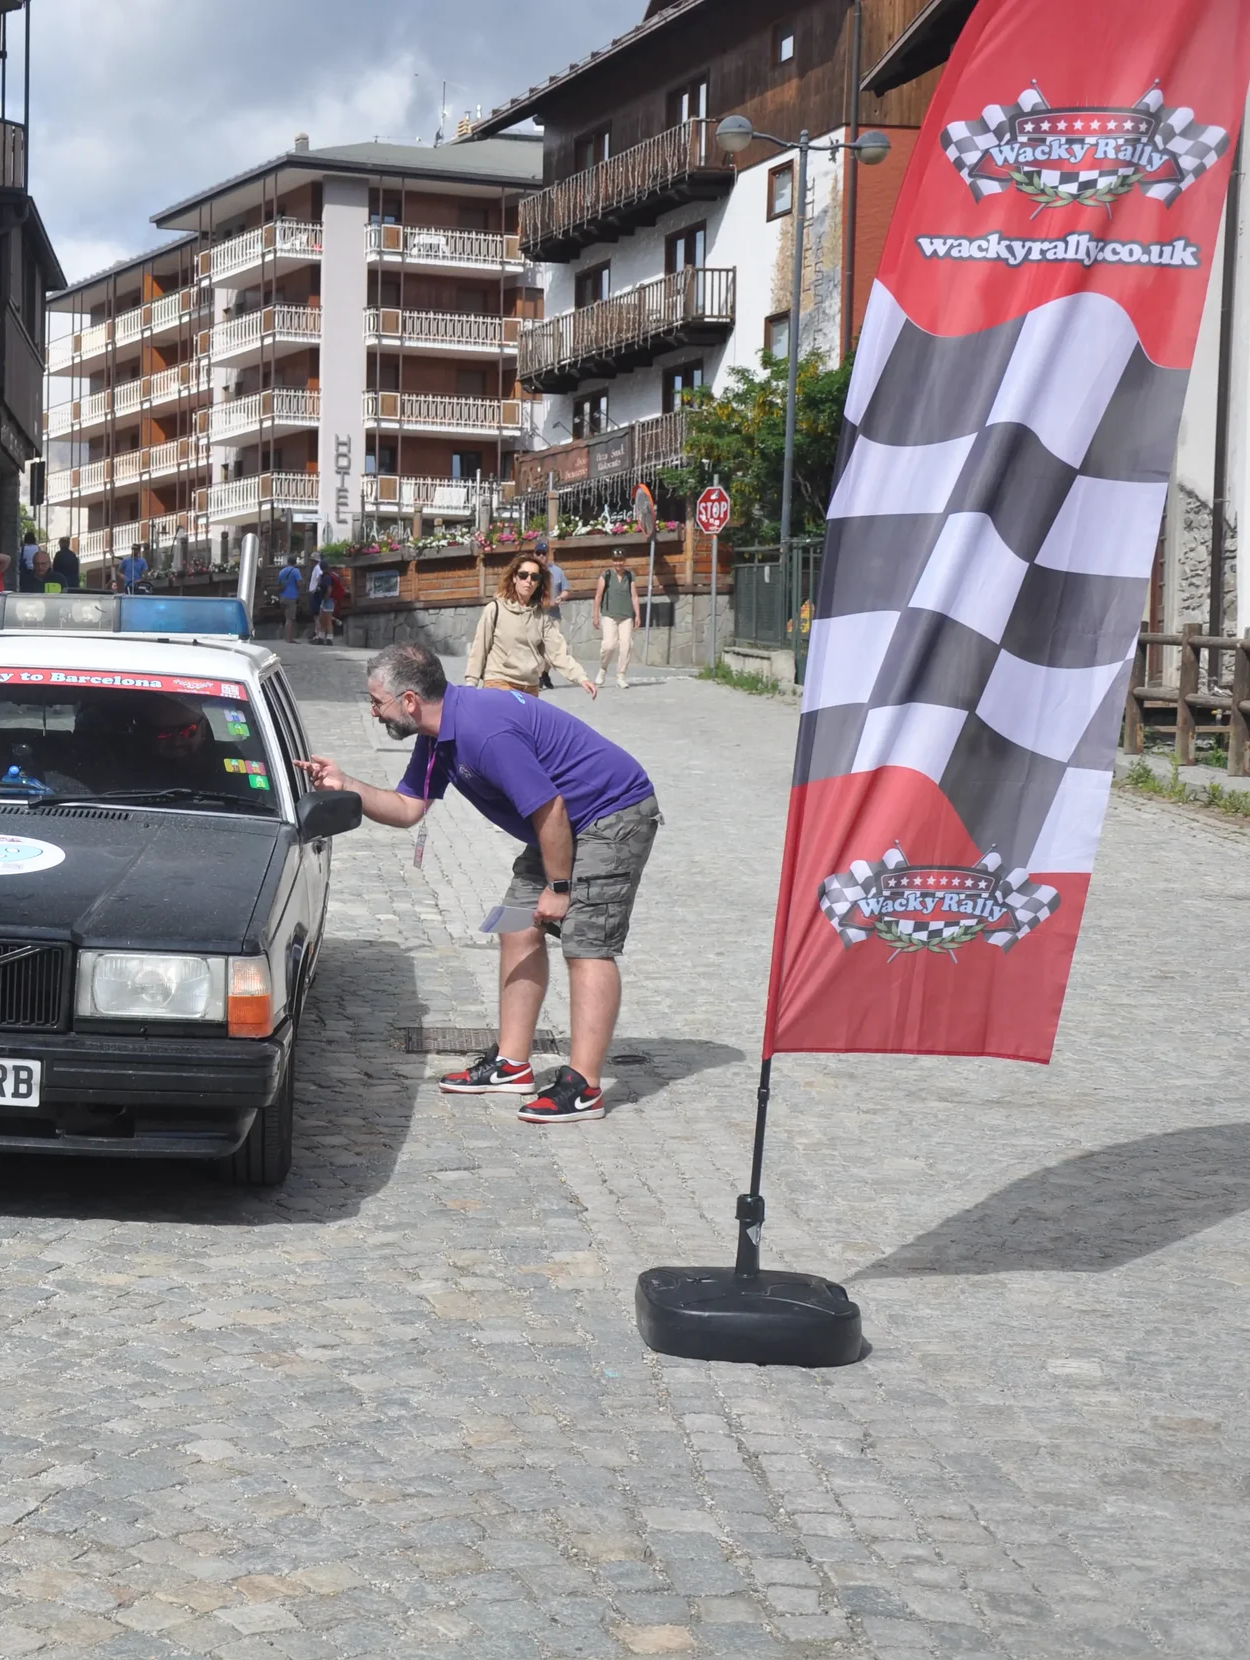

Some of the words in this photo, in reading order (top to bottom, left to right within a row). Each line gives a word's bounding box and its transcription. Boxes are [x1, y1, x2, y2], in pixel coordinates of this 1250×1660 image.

[988, 138, 1091, 166] Wacky
[1094, 137, 1170, 172] Rally
[917, 233, 1199, 267] wackyrally.co.uk
[335, 433, 351, 524] HOTEL
[699, 501, 728, 521] STOP
[19, 671, 44, 683] to
[49, 672, 163, 689] Barcelona
[857, 892, 940, 917] Wacky
[941, 893, 1007, 922] Rally
